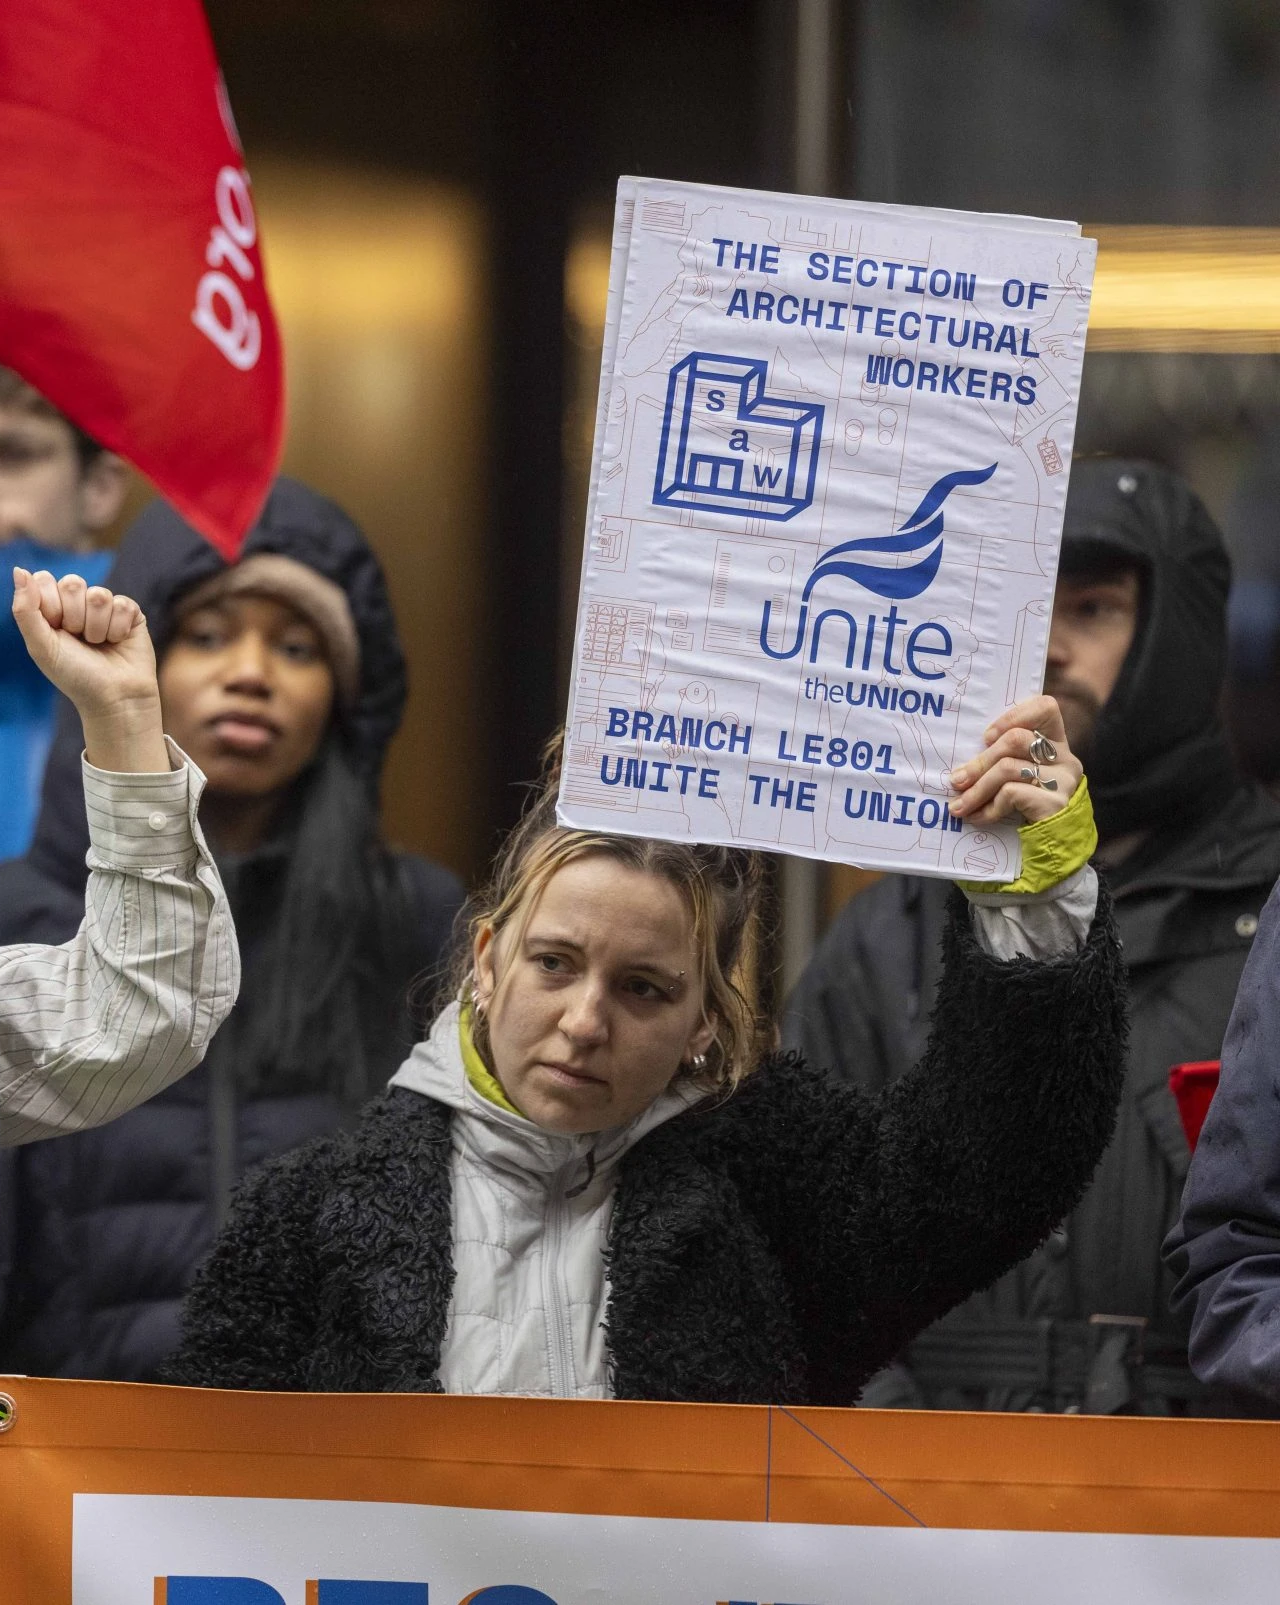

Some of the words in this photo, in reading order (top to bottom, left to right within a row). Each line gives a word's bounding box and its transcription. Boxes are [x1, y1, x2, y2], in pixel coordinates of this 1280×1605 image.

[712, 237, 782, 275] THE
[806, 252, 977, 302] SECTION
[1001, 278, 1050, 311] OF
[725, 288, 1040, 359] ARCHITECTURAL
[865, 353, 1038, 406] WORKERS
[605, 707, 752, 755] BRANCH
[777, 730, 897, 776] LE801
[600, 755, 721, 799] UNITE
[748, 774, 817, 813] THE
